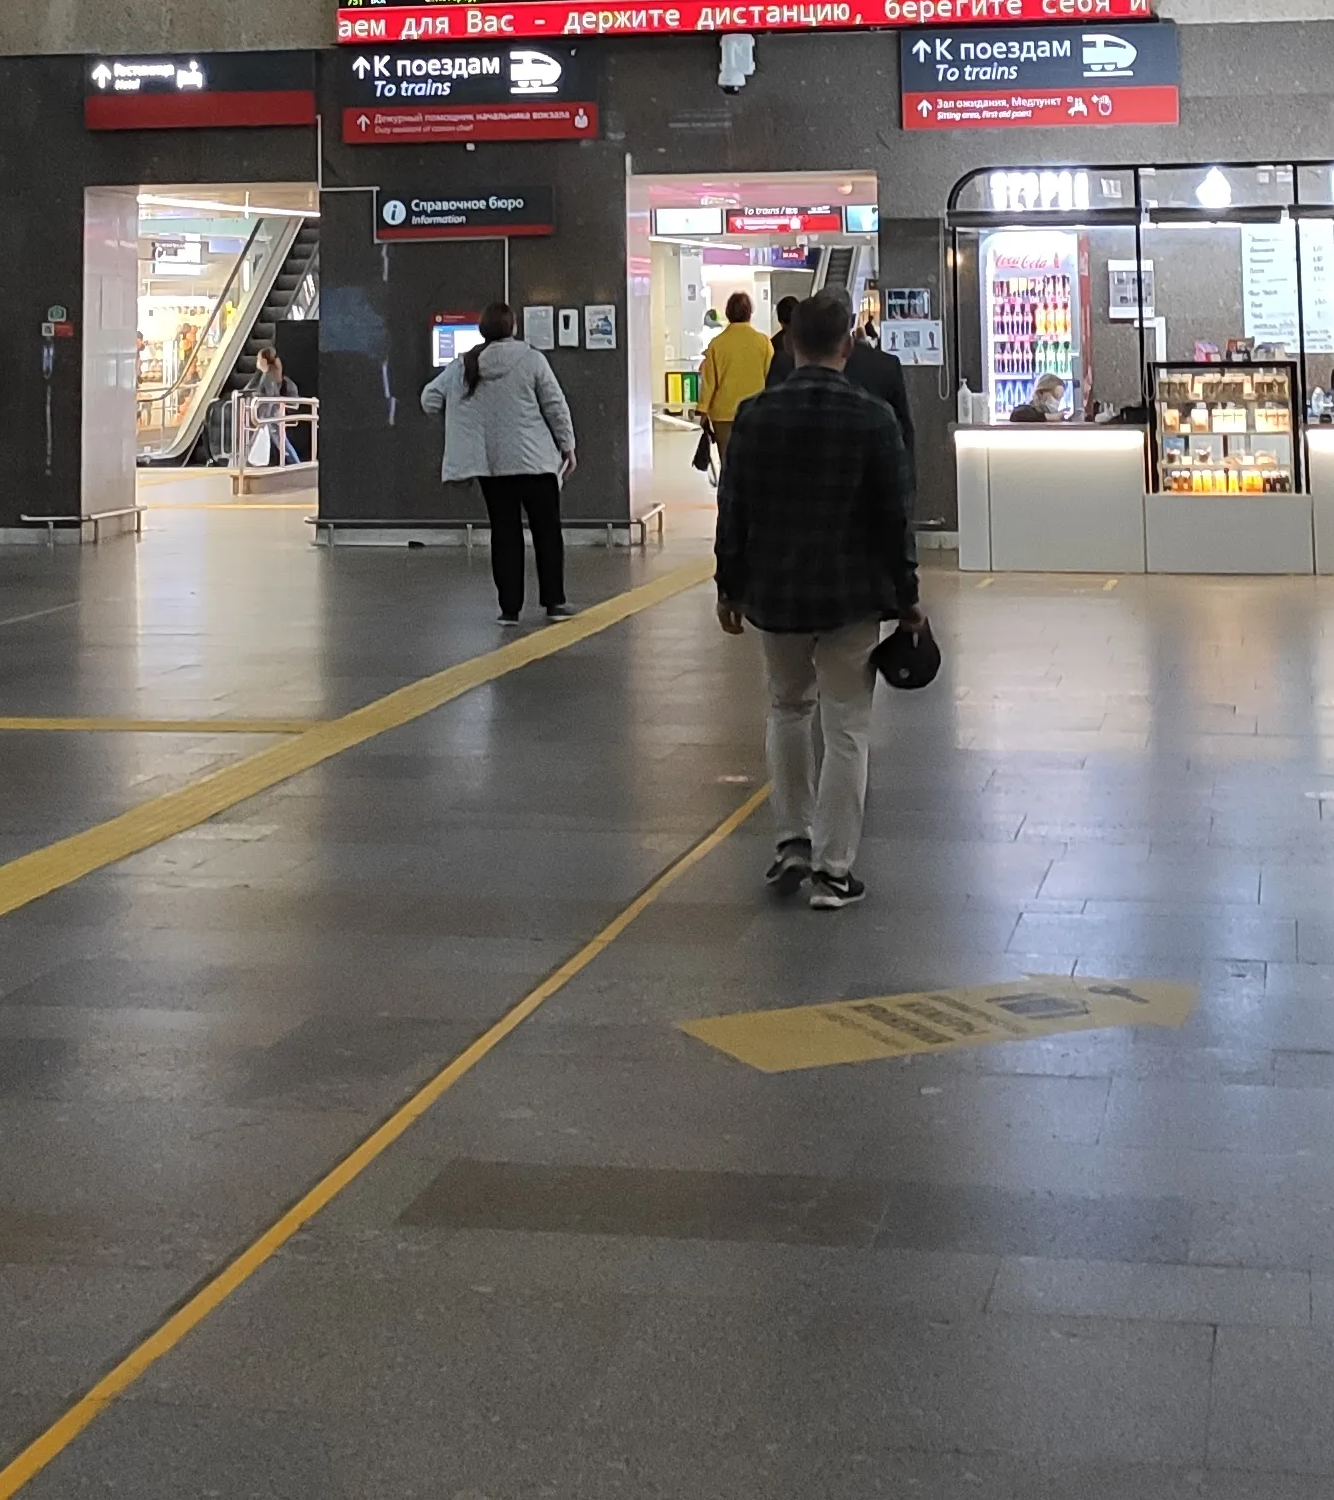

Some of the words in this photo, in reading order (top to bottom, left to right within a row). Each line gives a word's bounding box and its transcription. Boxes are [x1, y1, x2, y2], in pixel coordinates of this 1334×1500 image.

[401, 17, 449, 40] для
[466, 11, 514, 33] Вас
[564, 8, 681, 35] держите
[697, 1, 862, 30] дистанцию,
[935, 39, 953, 59] К
[960, 39, 1071, 62] поездам
[374, 55, 391, 77] К
[397, 57, 500, 79] поездам
[936, 64, 959, 82] To
[964, 62, 1018, 81] trains
[375, 81, 397, 97] To
[400, 79, 451, 96] trains
[937, 98, 955, 109] Зал
[957, 97, 1009, 109] ожидания,
[1011, 96, 1061, 108] Медпункт
[937, 111, 960, 121] Sitting
[411, 199, 485, 214] Справочное
[489, 196, 524, 211] бюро
[412, 215, 466, 225] Information
